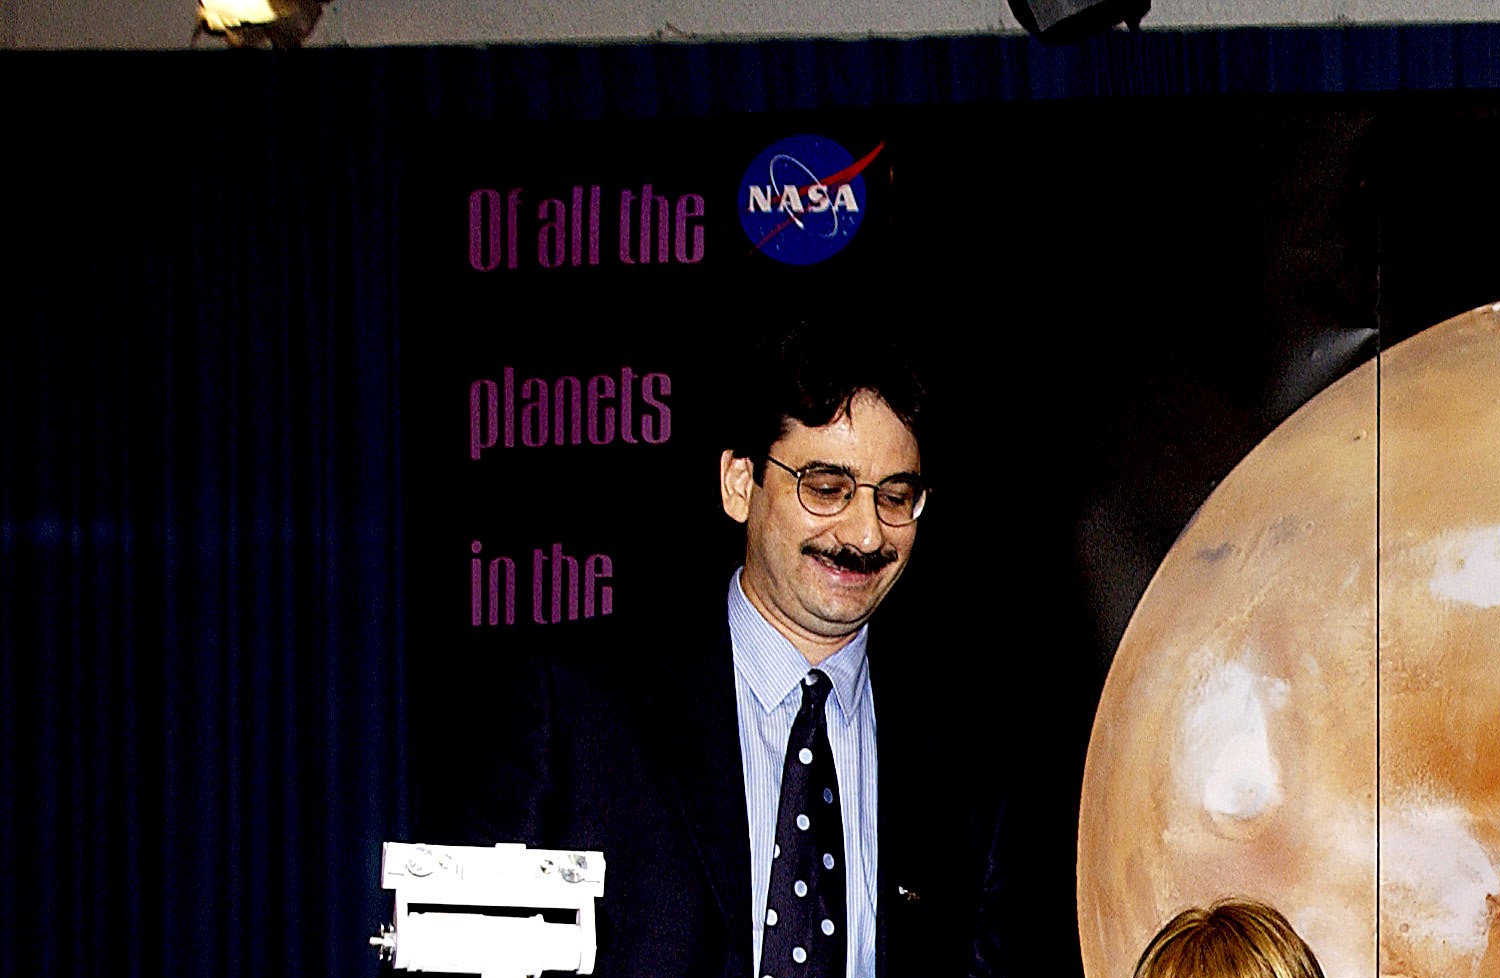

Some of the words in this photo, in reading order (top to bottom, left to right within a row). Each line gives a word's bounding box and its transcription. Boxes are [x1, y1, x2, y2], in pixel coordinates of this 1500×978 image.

[469, 187, 523, 272] Of
[537, 185, 601, 268] all
[618, 183, 705, 265] the
[748, 183, 860, 213] NASA
[469, 366, 672, 461] planets
[470, 538, 516, 627] in
[531, 542, 613, 625] the
